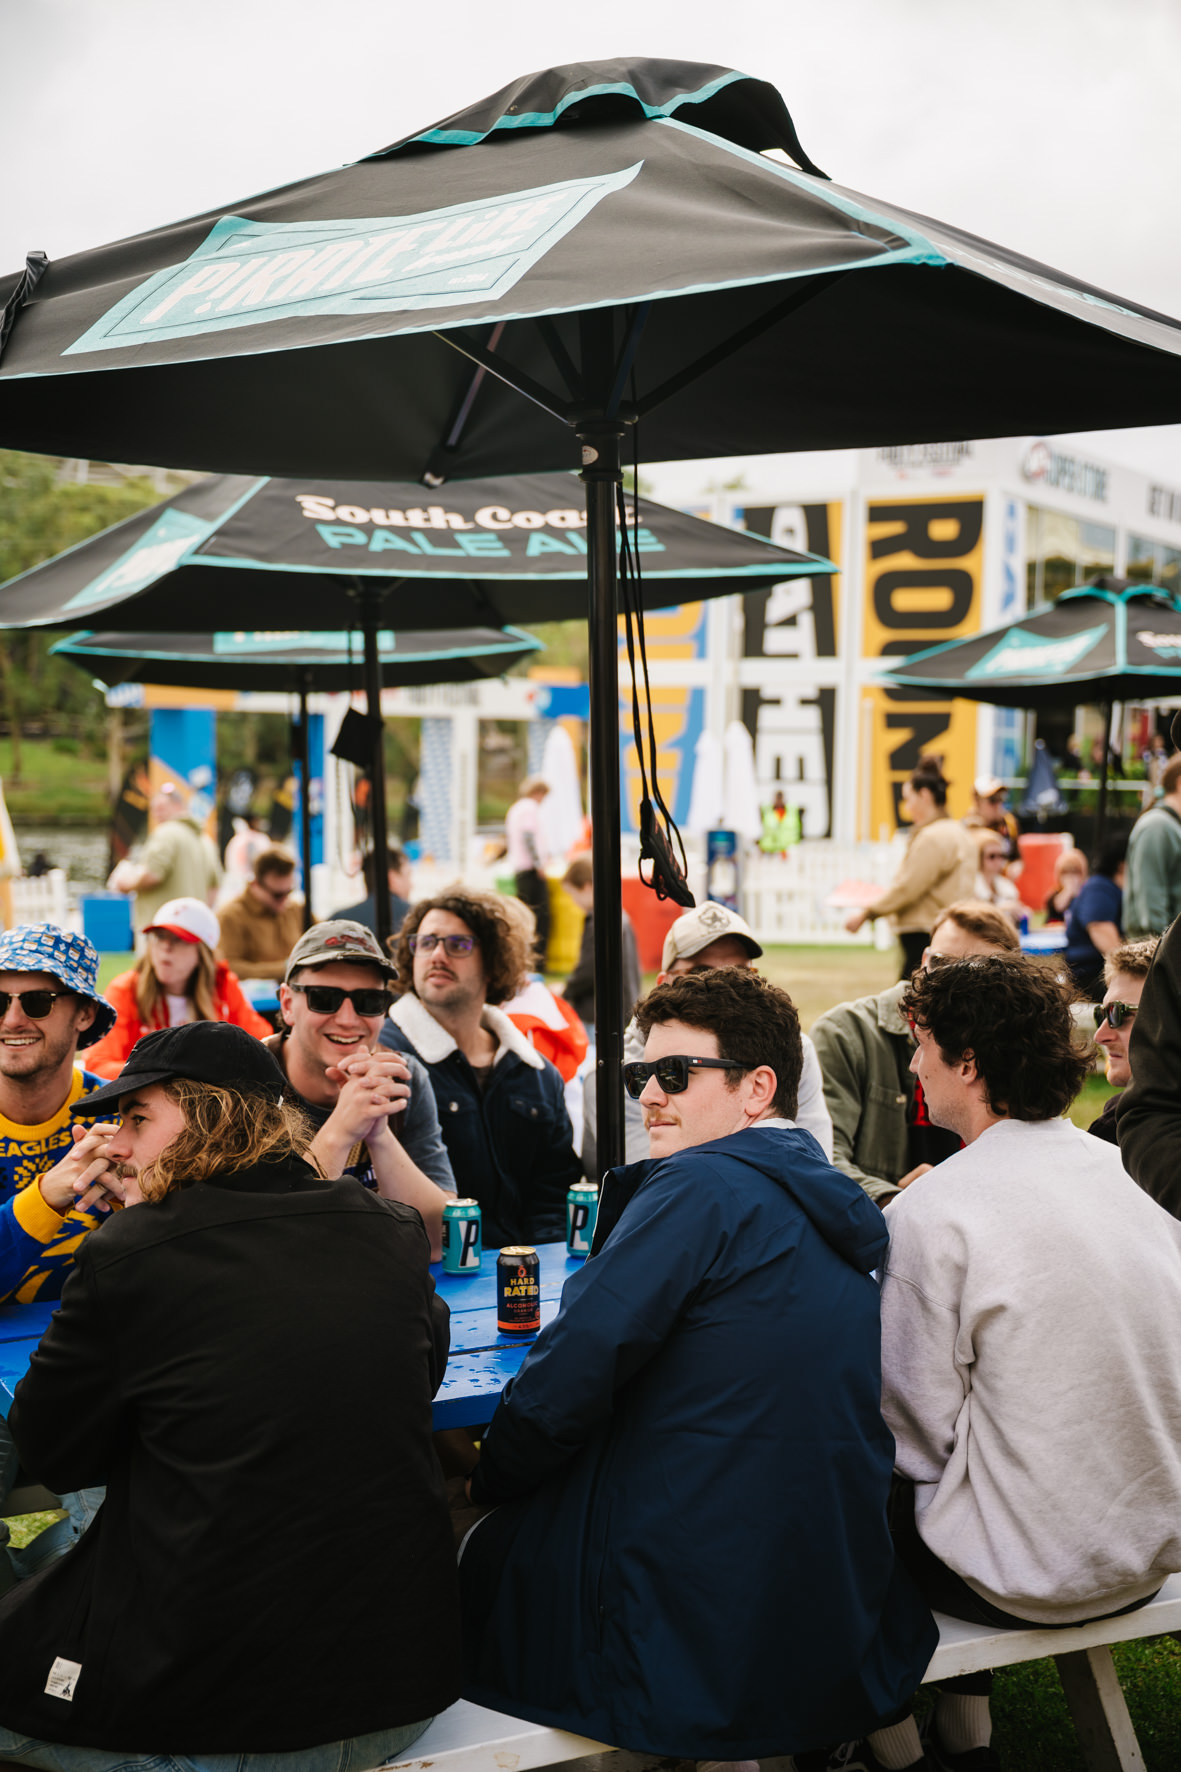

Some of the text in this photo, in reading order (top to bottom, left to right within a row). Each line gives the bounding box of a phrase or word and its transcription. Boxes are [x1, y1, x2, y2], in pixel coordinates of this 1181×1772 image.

[295, 494, 643, 530] South Coat
[315, 523, 511, 557] PALE
[868, 500, 984, 828] RON
[504, 1285, 539, 1297] RATED
[510, 1277, 535, 1286] HARD
